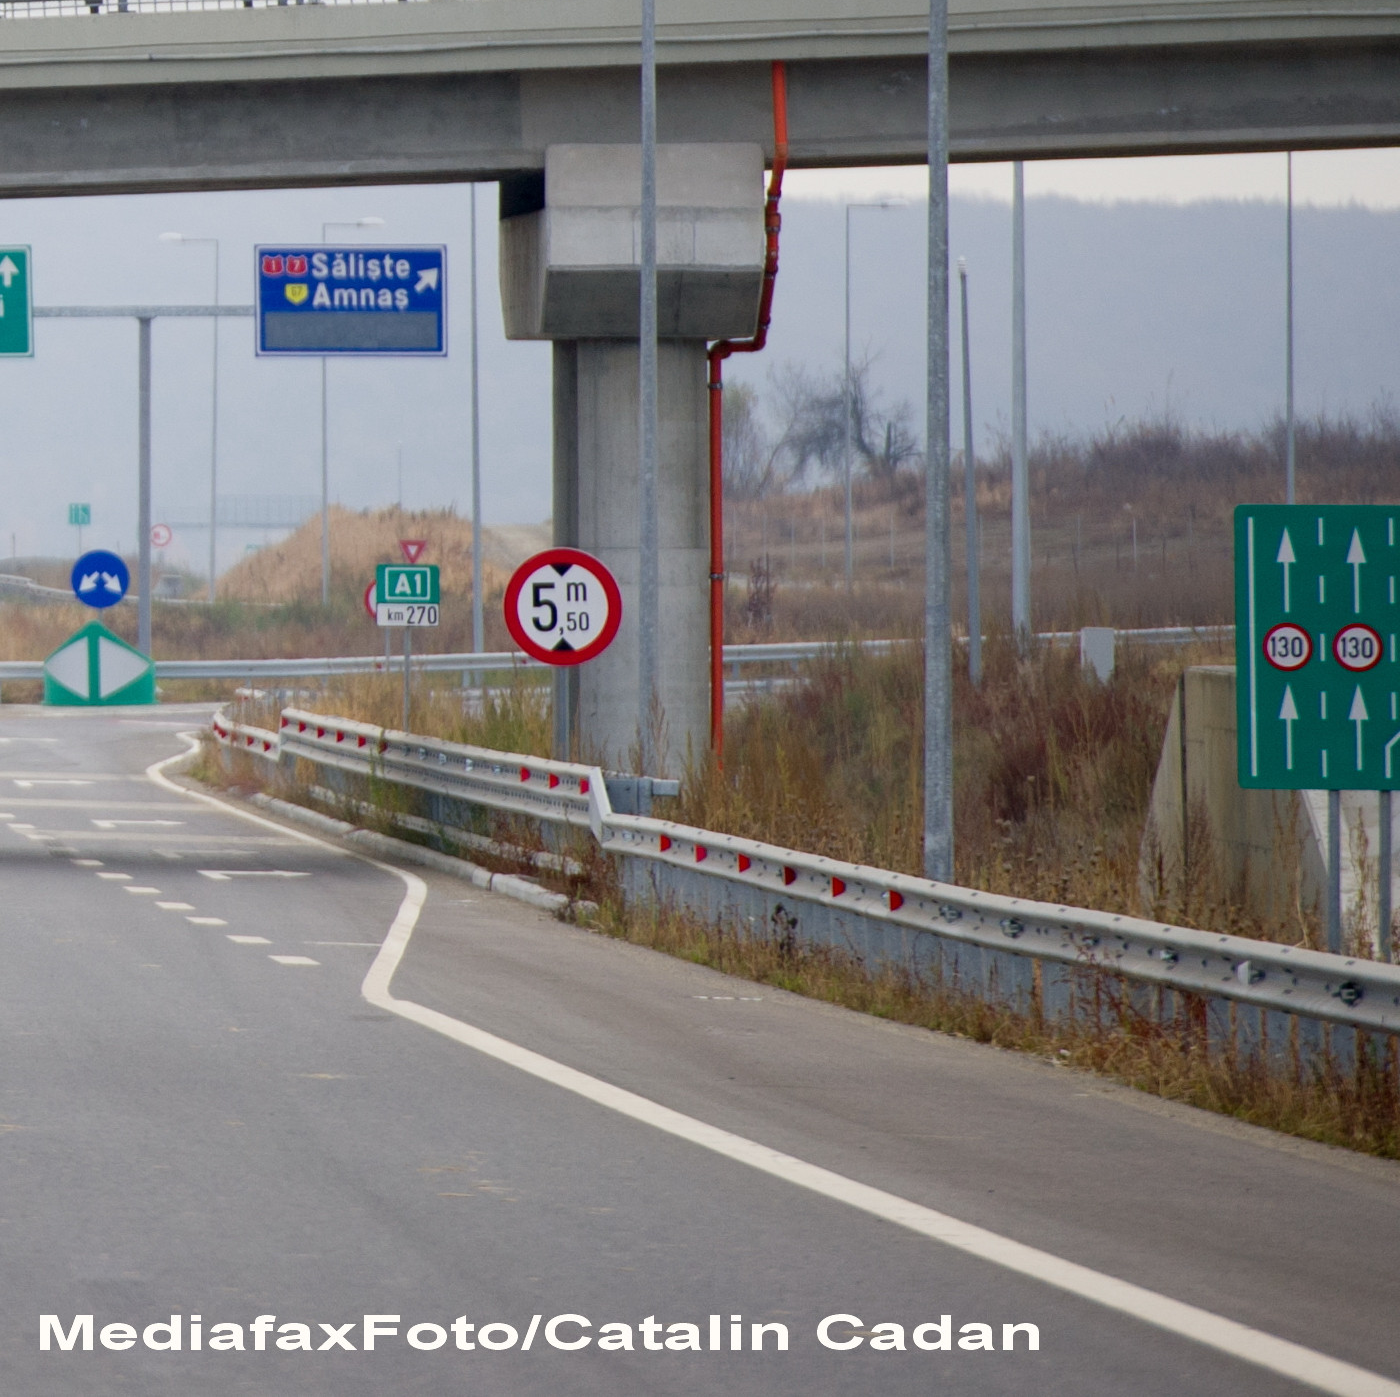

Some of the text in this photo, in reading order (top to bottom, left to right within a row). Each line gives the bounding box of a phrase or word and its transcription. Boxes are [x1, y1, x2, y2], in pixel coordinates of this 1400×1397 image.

[293, 260, 300, 271] 7
[311, 252, 411, 282] Săliște
[394, 573, 422, 594] A1
[566, 582, 588, 602] m
[387, 605, 438, 625] km 270
[1270, 636, 1304, 658] 130
[1340, 636, 1374, 659] 130
